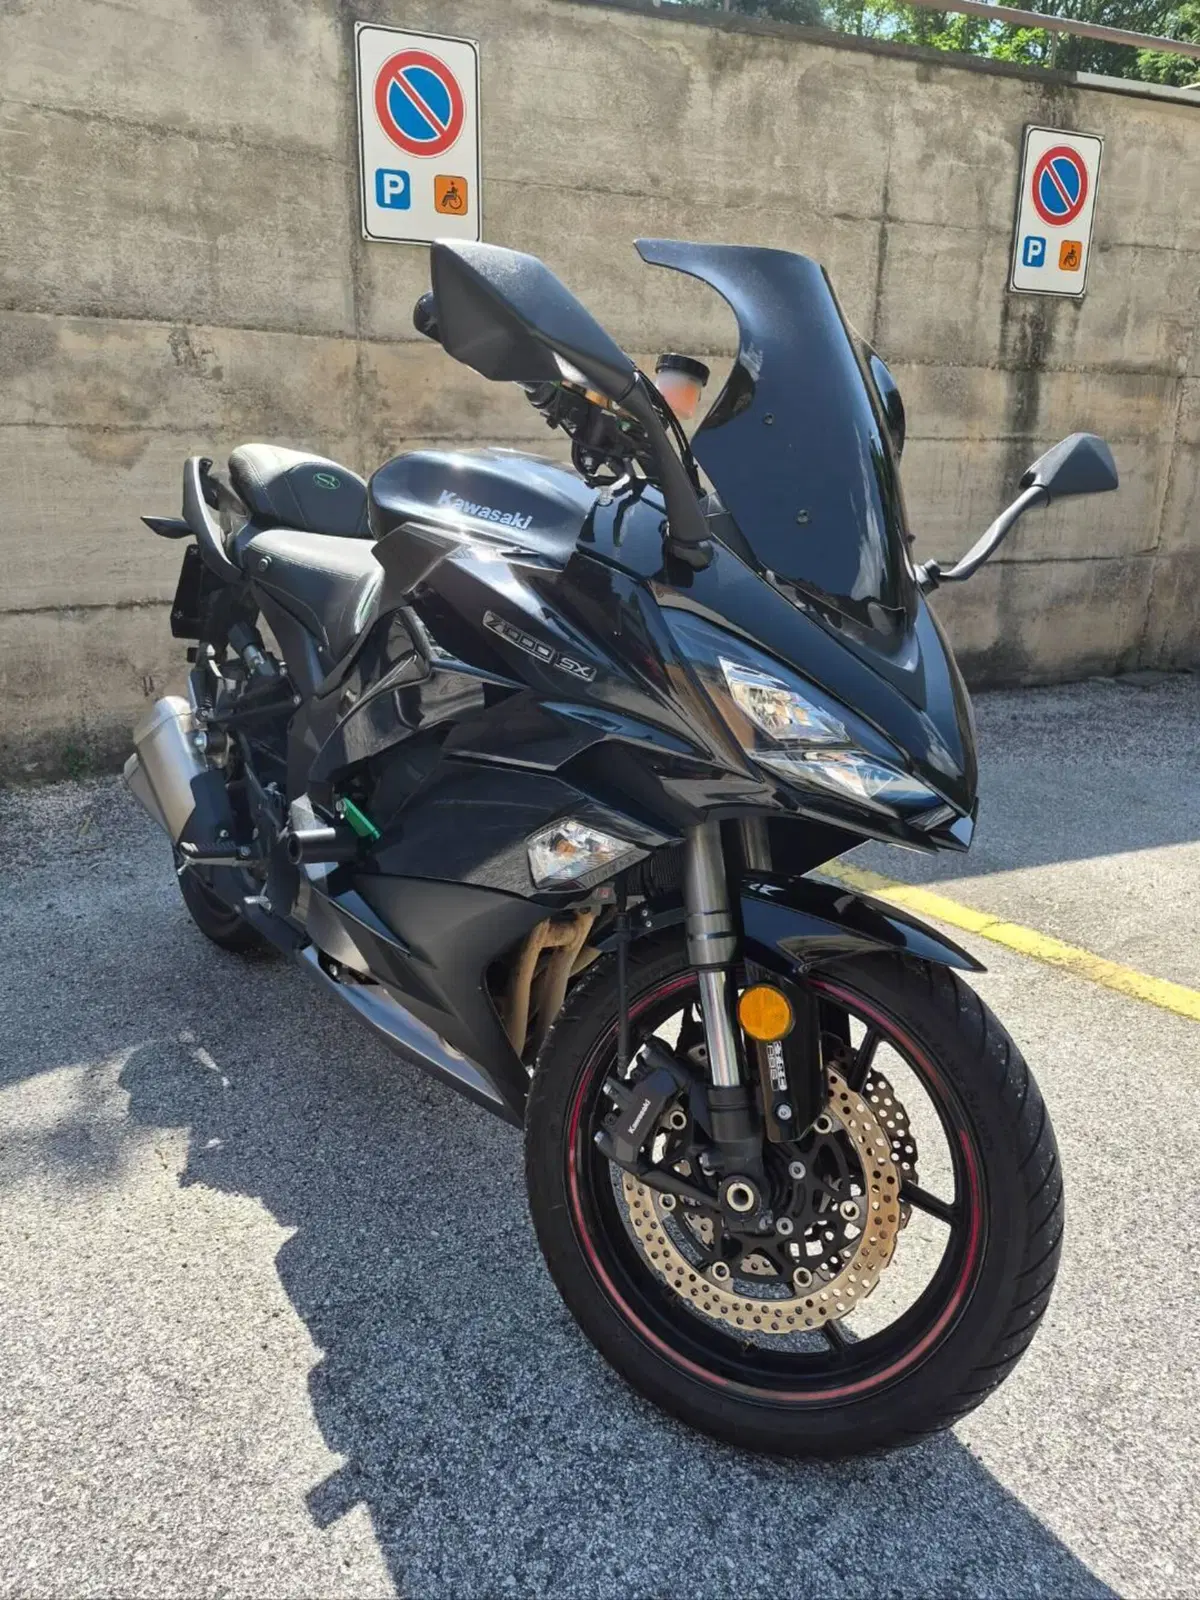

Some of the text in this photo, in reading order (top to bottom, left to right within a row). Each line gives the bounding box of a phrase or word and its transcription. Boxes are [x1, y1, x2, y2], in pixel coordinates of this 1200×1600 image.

[383, 173, 405, 204] P
[1027, 240, 1042, 264] P
[437, 489, 533, 530] Kawasaki
[557, 657, 591, 677] SX
[628, 1098, 651, 1134] Kawasaki
